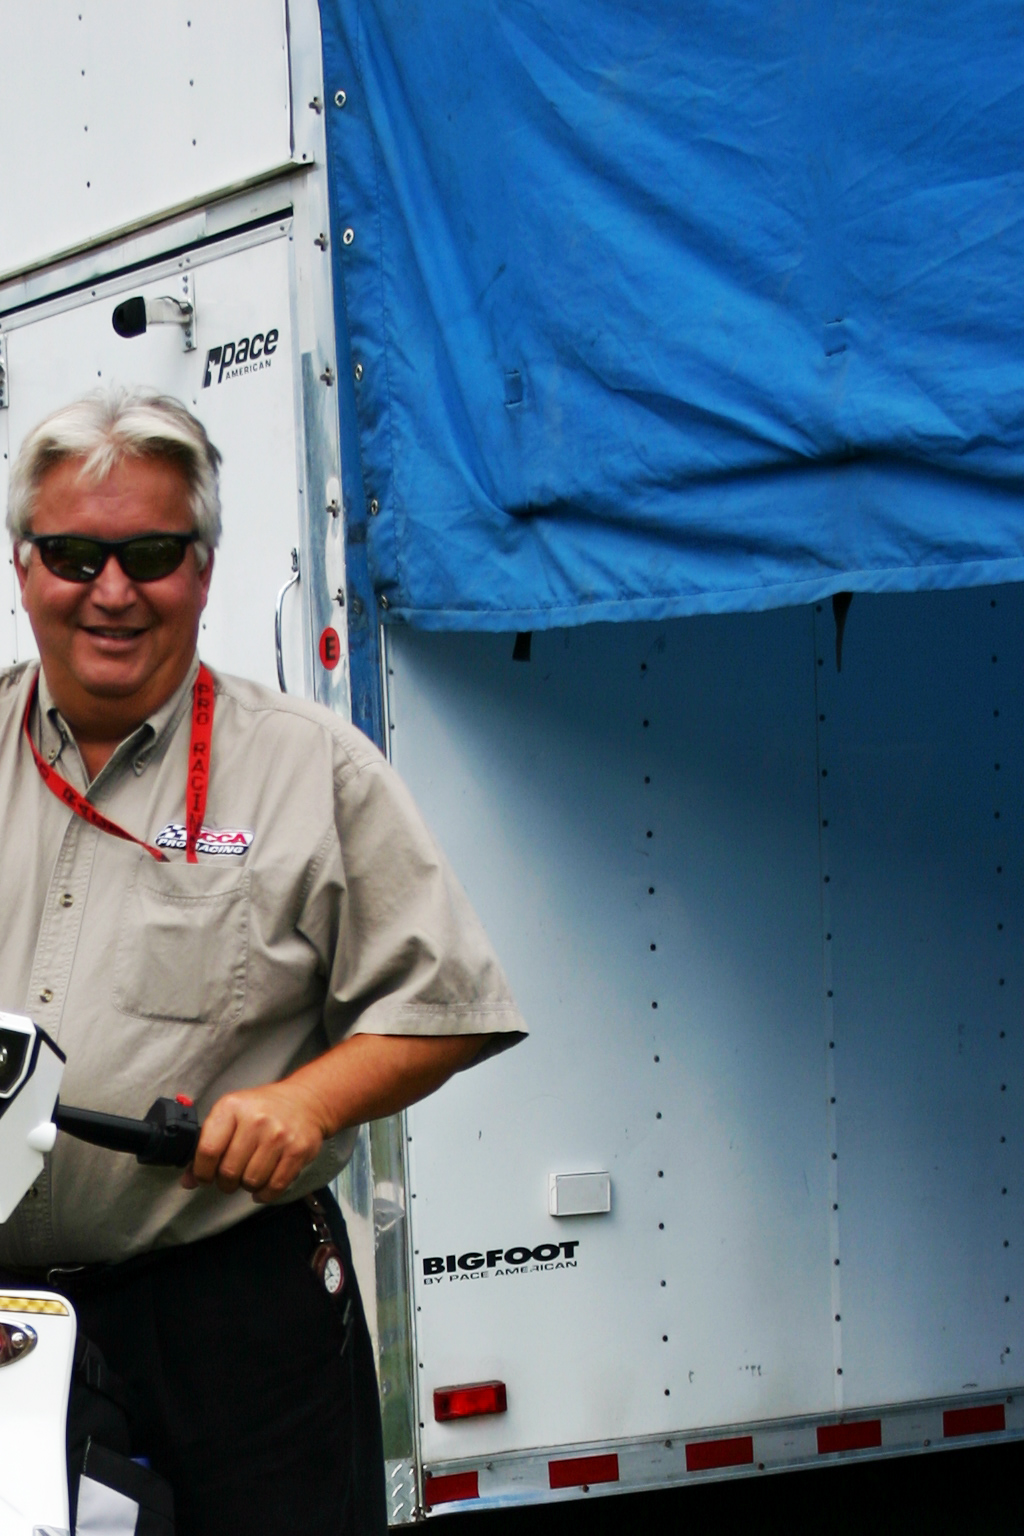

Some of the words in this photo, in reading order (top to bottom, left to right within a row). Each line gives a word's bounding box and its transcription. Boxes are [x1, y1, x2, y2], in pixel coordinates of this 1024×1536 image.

[217, 328, 279, 384] pace
[226, 359, 272, 380] AMERICAN
[325, 636, 336, 660] E
[196, 684, 210, 726] PRO
[158, 838, 187, 848] PRO
[195, 843, 244, 854] ACING
[200, 831, 248, 845] CCA
[423, 1240, 580, 1276] BIGFOOT
[423, 1276, 443, 1286] BY
[449, 1270, 489, 1283] PACE
[494, 1260, 578, 1277] AMERICAN
